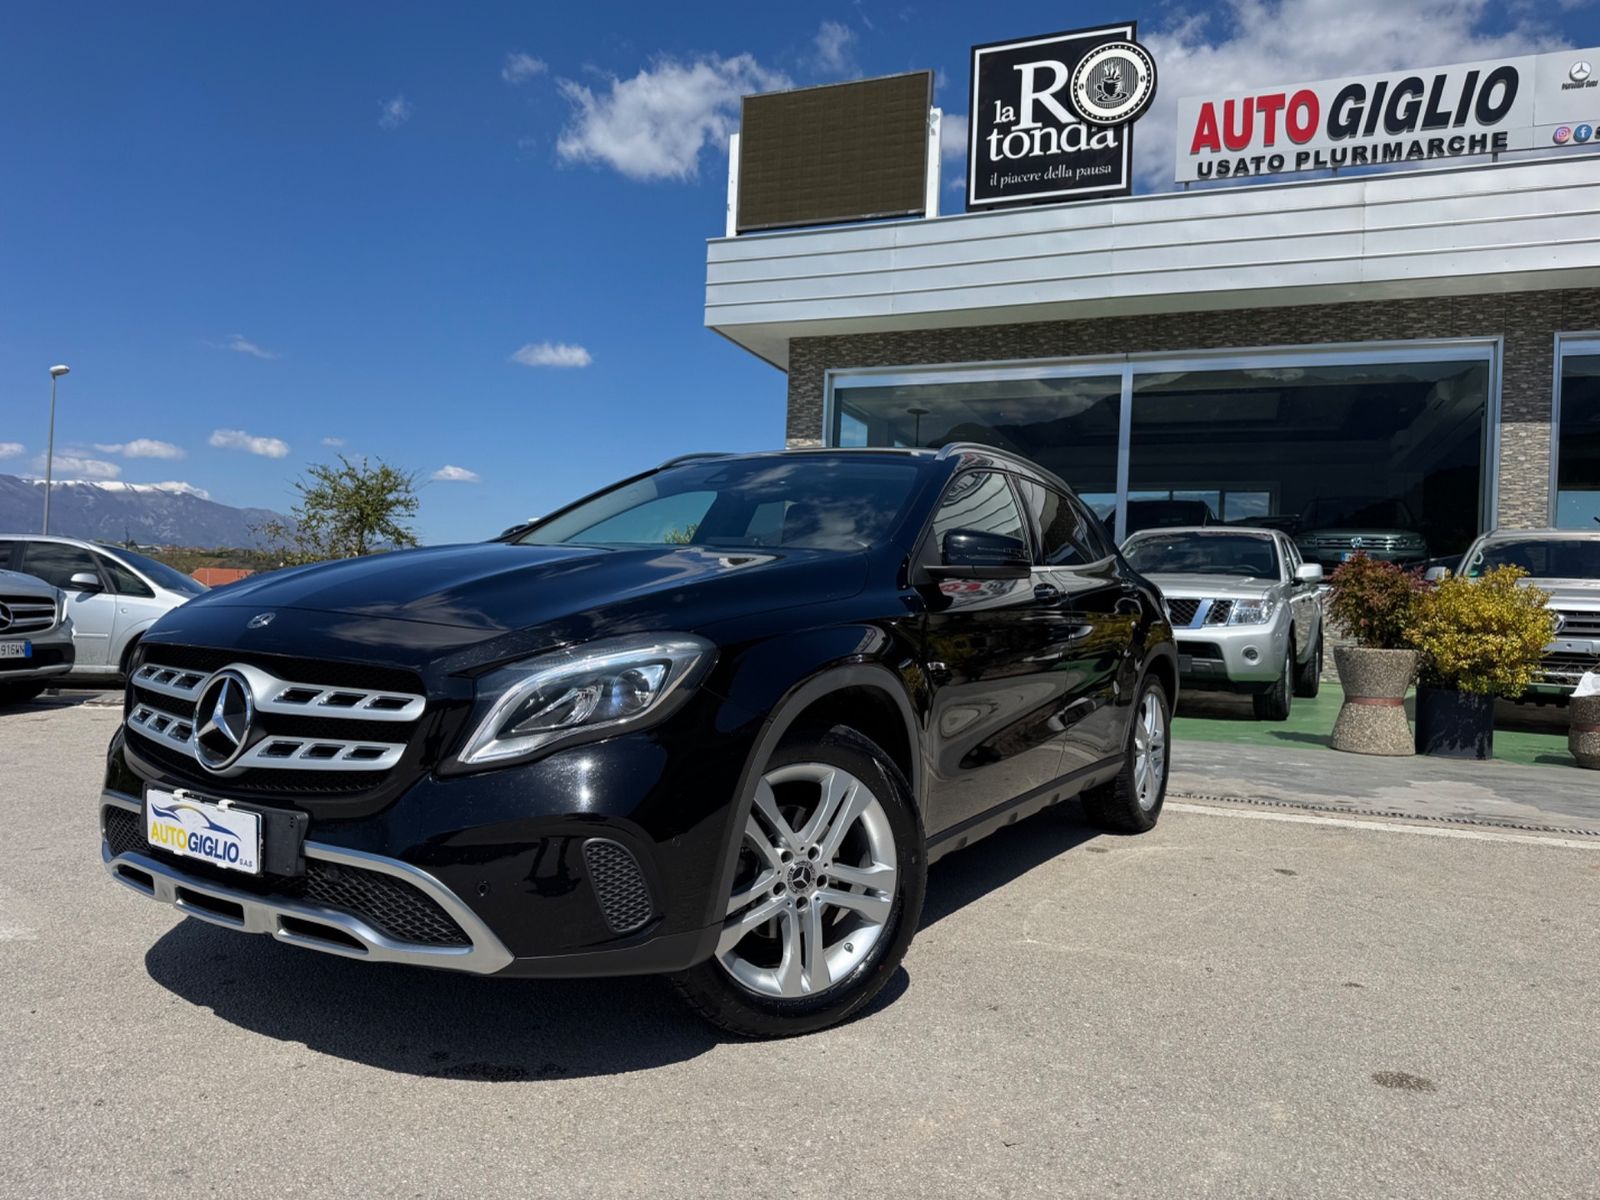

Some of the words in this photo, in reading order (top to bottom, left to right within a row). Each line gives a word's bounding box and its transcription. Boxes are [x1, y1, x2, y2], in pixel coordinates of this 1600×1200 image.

[993, 100, 1016, 124] la
[1190, 89, 1320, 155] AUTO
[1327, 65, 1520, 142] GIGLIO
[986, 121, 1118, 162] tonda
[1197, 153, 1269, 179] USATO
[1295, 131, 1508, 171] PLURIMARCHE
[990, 172, 998, 186] il
[1000, 172, 1041, 189] piacere
[1044, 164, 1072, 180] della
[1075, 164, 1112, 181] pausa
